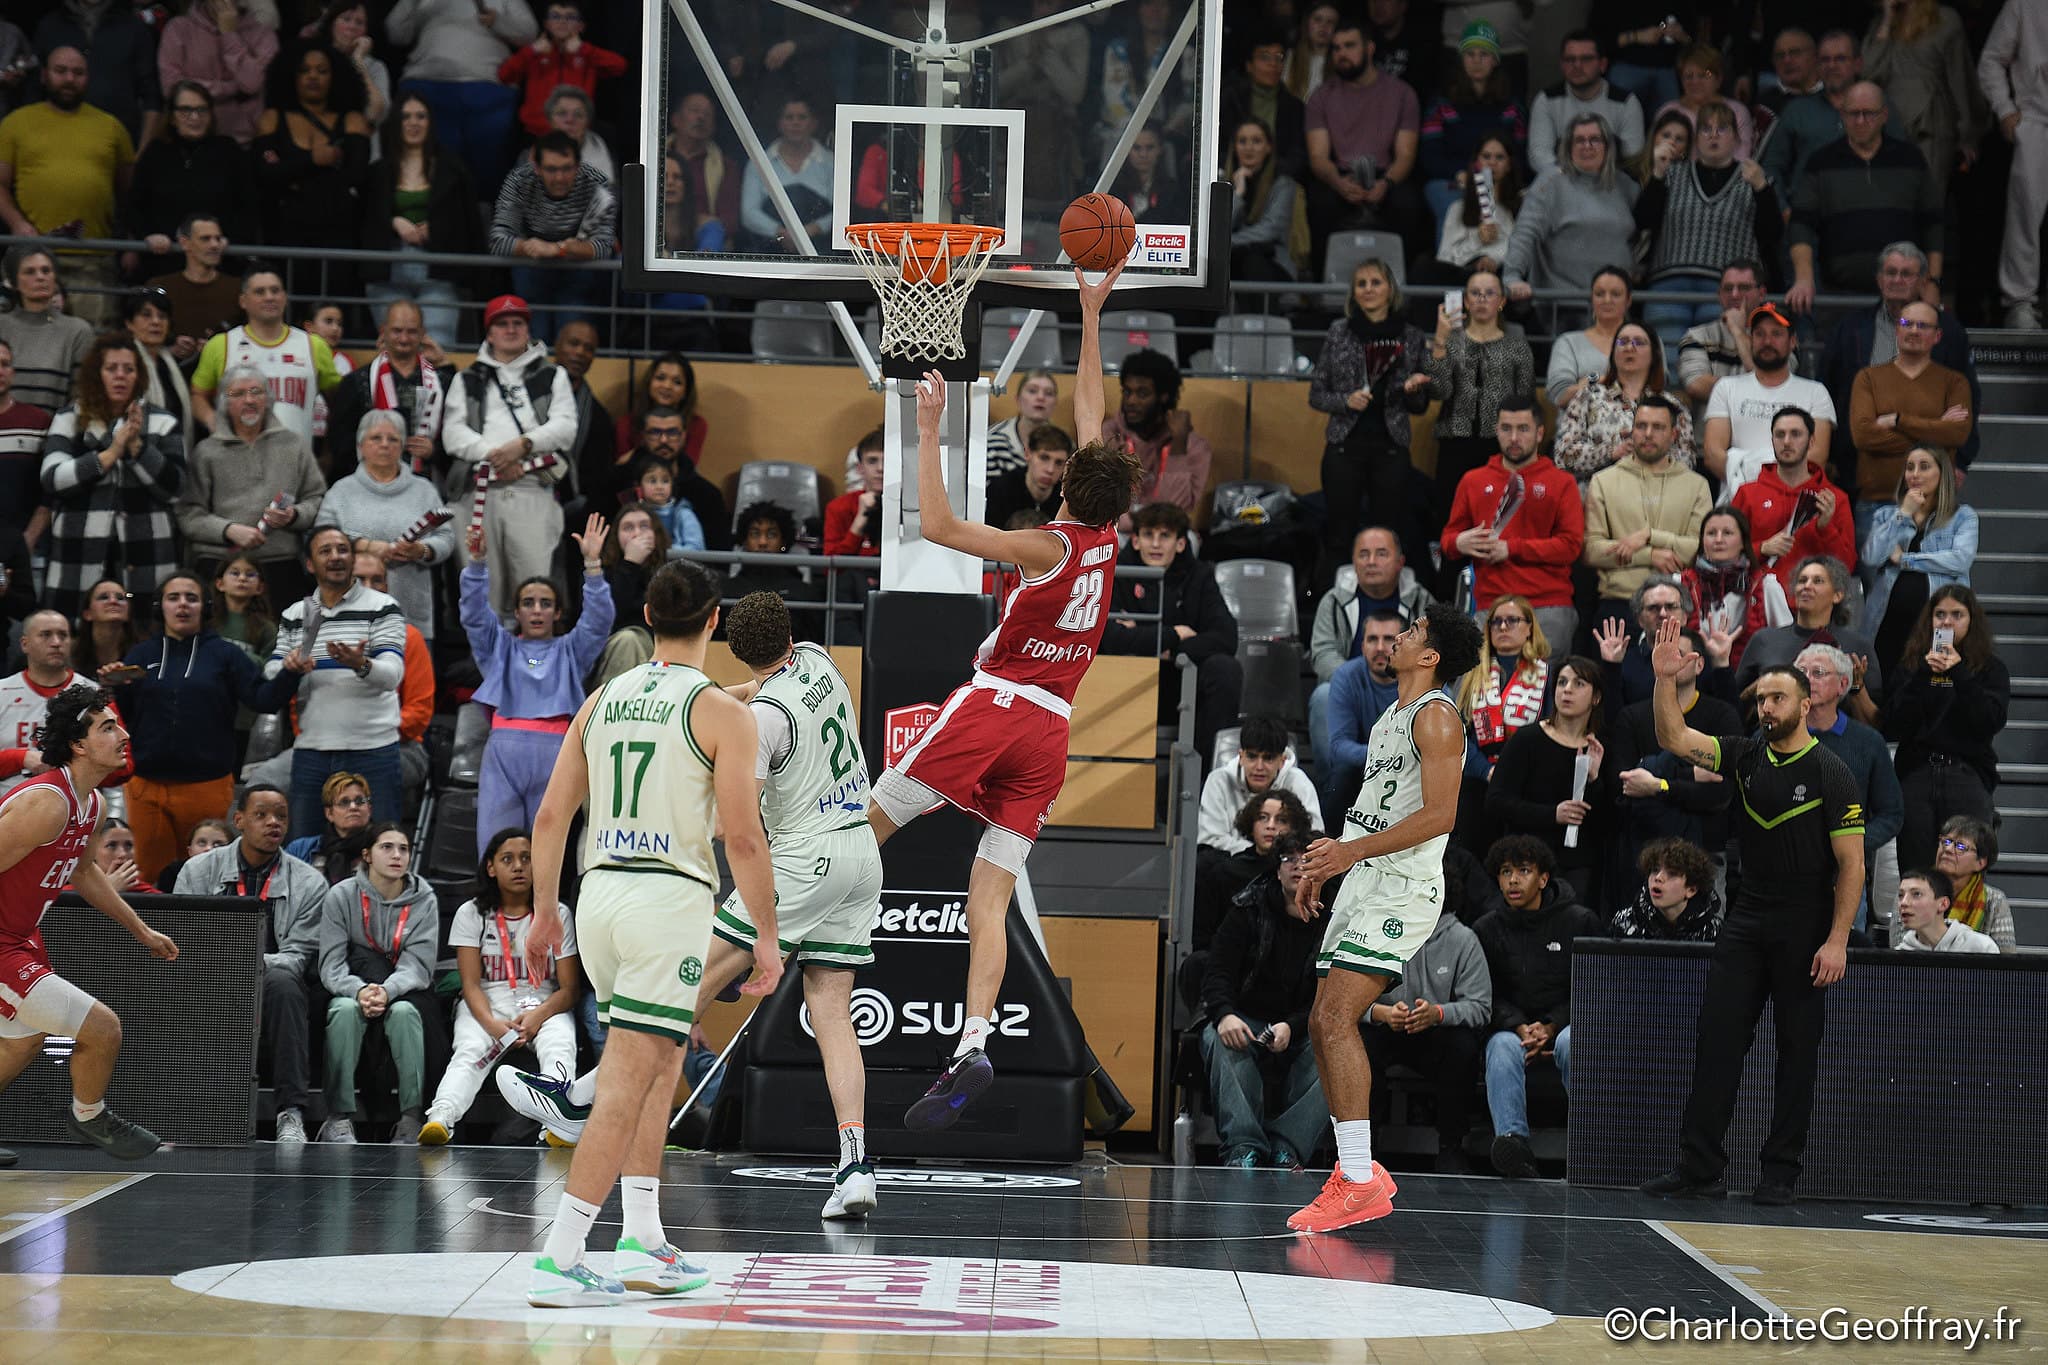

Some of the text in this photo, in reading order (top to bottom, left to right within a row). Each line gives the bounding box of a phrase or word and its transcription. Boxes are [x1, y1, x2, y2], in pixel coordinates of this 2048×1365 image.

[1147, 236, 1184, 247] Betclic
[1147, 250, 1183, 263] ÉLITE
[1055, 568, 1104, 632] 22
[992, 689, 1016, 709] 22
[604, 698, 676, 726] AMSELLEM
[820, 701, 860, 783] 21
[610, 741, 656, 819] 17
[1379, 779, 1398, 812] 2
[813, 857, 831, 877] 21
[1428, 886, 1438, 904] 2
